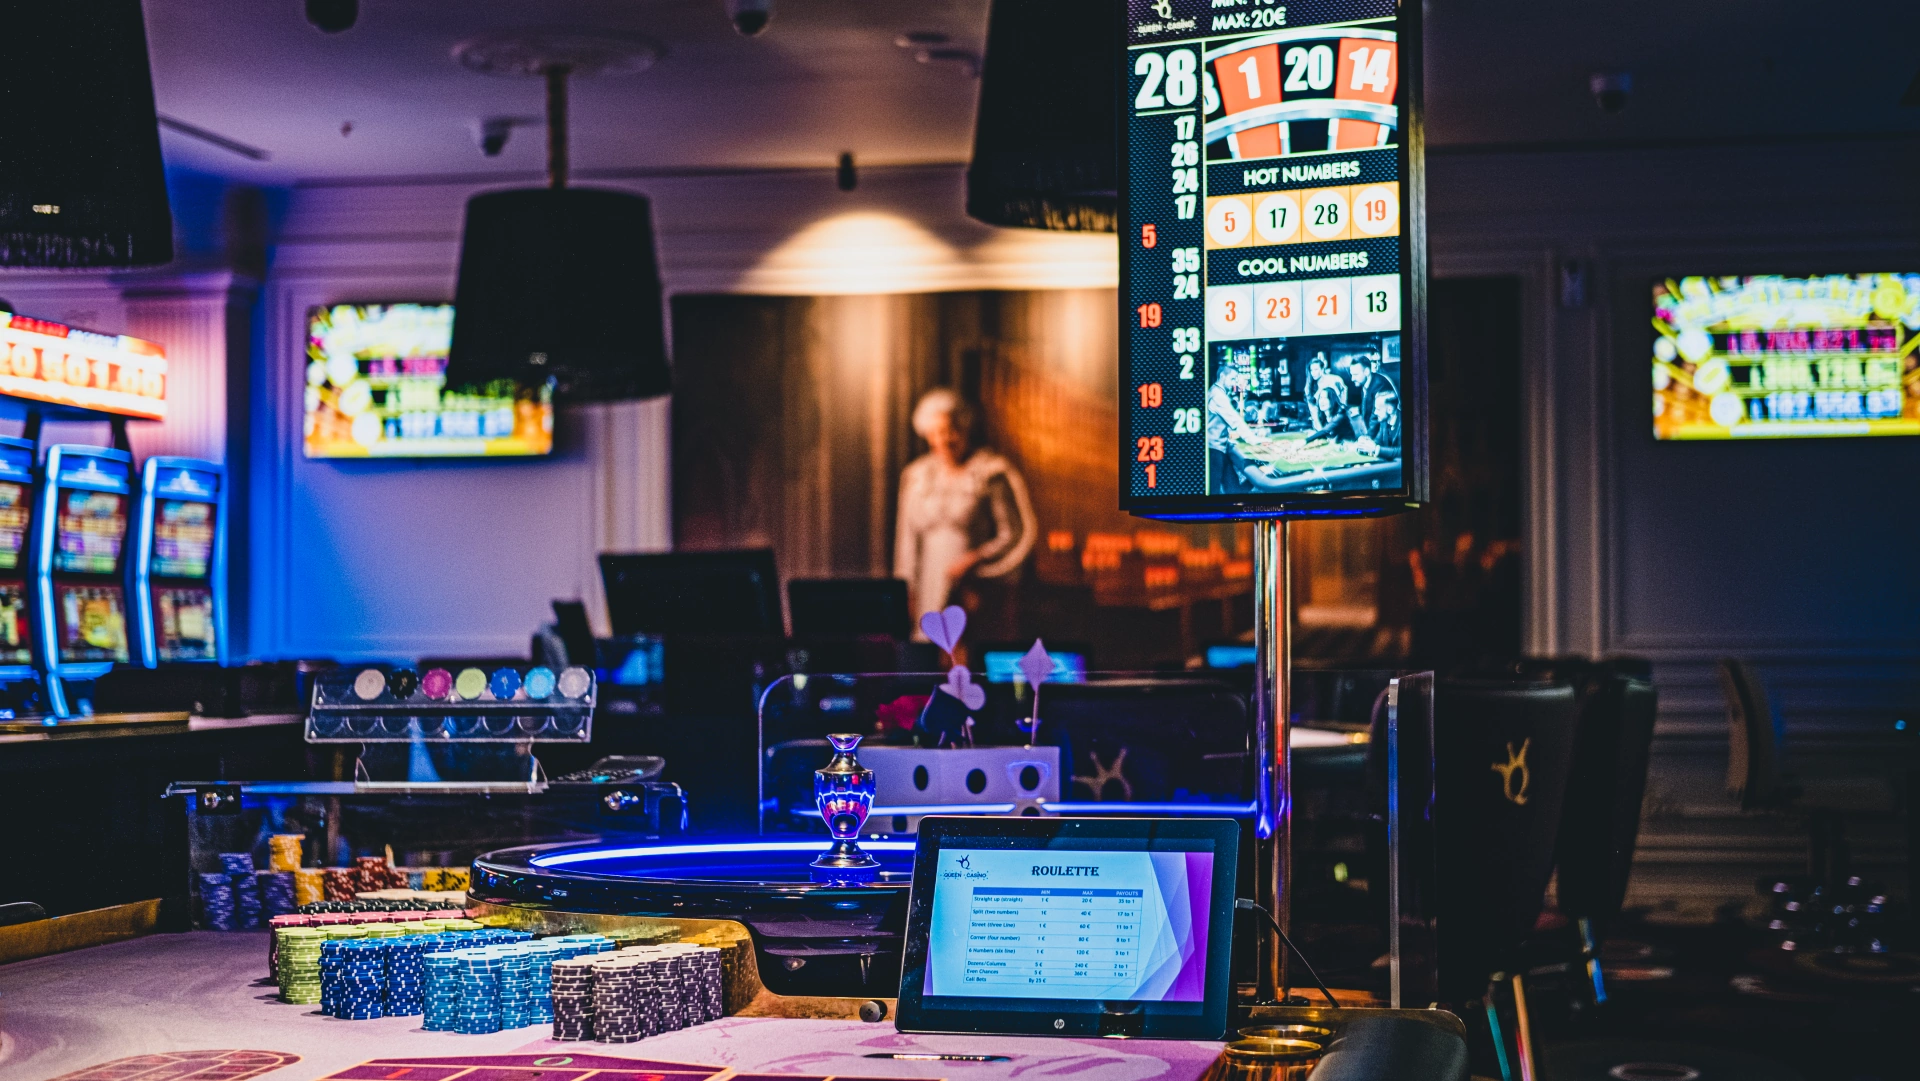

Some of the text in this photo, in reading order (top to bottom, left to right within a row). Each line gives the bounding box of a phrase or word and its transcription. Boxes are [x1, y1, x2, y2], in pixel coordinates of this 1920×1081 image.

[1251, 6, 1287, 28] 20€
[1134, 49, 1197, 110] 28
[1238, 56, 1261, 99] 1
[1284, 45, 1333, 91] 20
[1349, 47, 1391, 93] 14
[1174, 116, 1196, 140] 17
[1171, 141, 1199, 168] 26
[1172, 168, 1199, 194] 24
[1243, 161, 1361, 186] HOT NUMBERS
[1174, 195, 1196, 220] 17
[1224, 199, 1386, 233] 5 17 28 19
[1141, 223, 1157, 249] 5
[1171, 248, 1200, 273] 35
[1237, 252, 1369, 276] COOL NUMBERS
[1173, 274, 1200, 300] 24
[1137, 302, 1162, 329] 19
[1225, 291, 1388, 323] 3 23 21 13
[1172, 327, 1201, 354] 33
[1179, 355, 1195, 380] 2
[1137, 383, 1163, 409] 19
[1173, 408, 1202, 434] 26
[1137, 436, 1165, 462] 23
[1144, 464, 1157, 489] 1
[1031, 865, 1100, 876] ROULETTE
